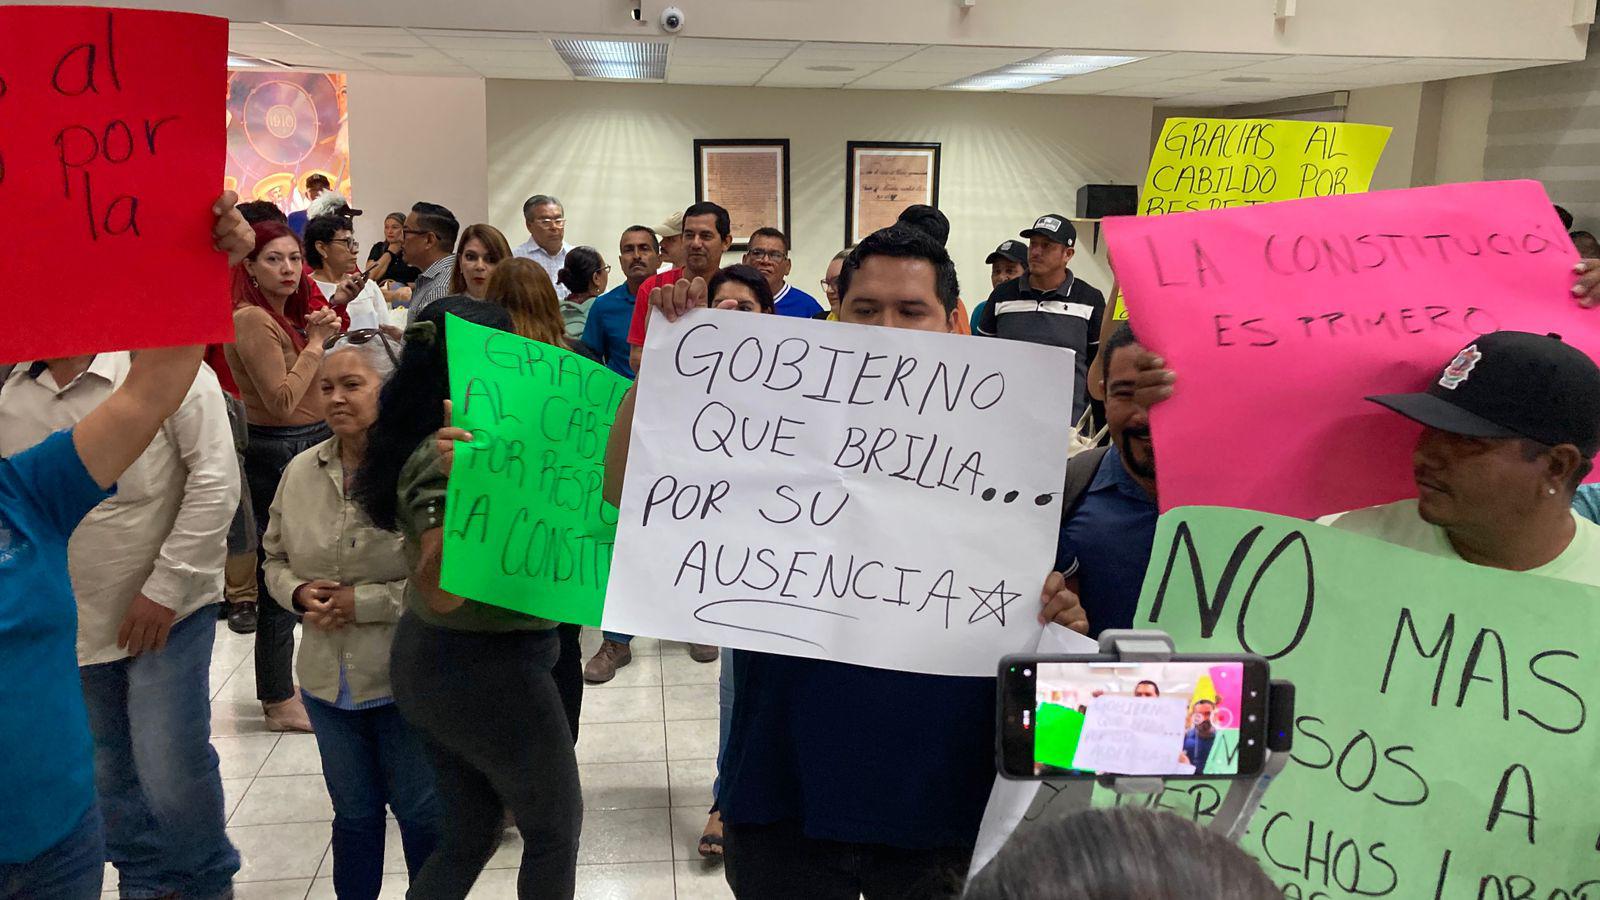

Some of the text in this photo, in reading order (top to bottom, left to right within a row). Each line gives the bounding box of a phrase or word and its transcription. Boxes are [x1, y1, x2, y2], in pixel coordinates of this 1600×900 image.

[51, 12, 121, 97] al
[269, 115, 295, 129] 1910
[1163, 120, 1349, 161] GRACIAS AL
[54, 114, 182, 198] por
[1151, 163, 1347, 197] CABILDO POR
[84, 170, 141, 241] la
[1145, 224, 1569, 288] LA CONSTITUCIÓN
[1213, 306, 1501, 347] ES PRIMERO
[485, 332, 632, 416] GRACI
[674, 322, 1006, 416] GOBIERNO
[464, 377, 523, 426] AL
[691, 401, 806, 458] QUE
[469, 428, 526, 489] POR
[449, 488, 490, 544] LA
[641, 475, 850, 527] POR SU
[673, 540, 964, 630] AUSENCIA
[1147, 520, 1315, 660] NO
[1379, 607, 1588, 735] MAS
[1485, 763, 1538, 845] A
